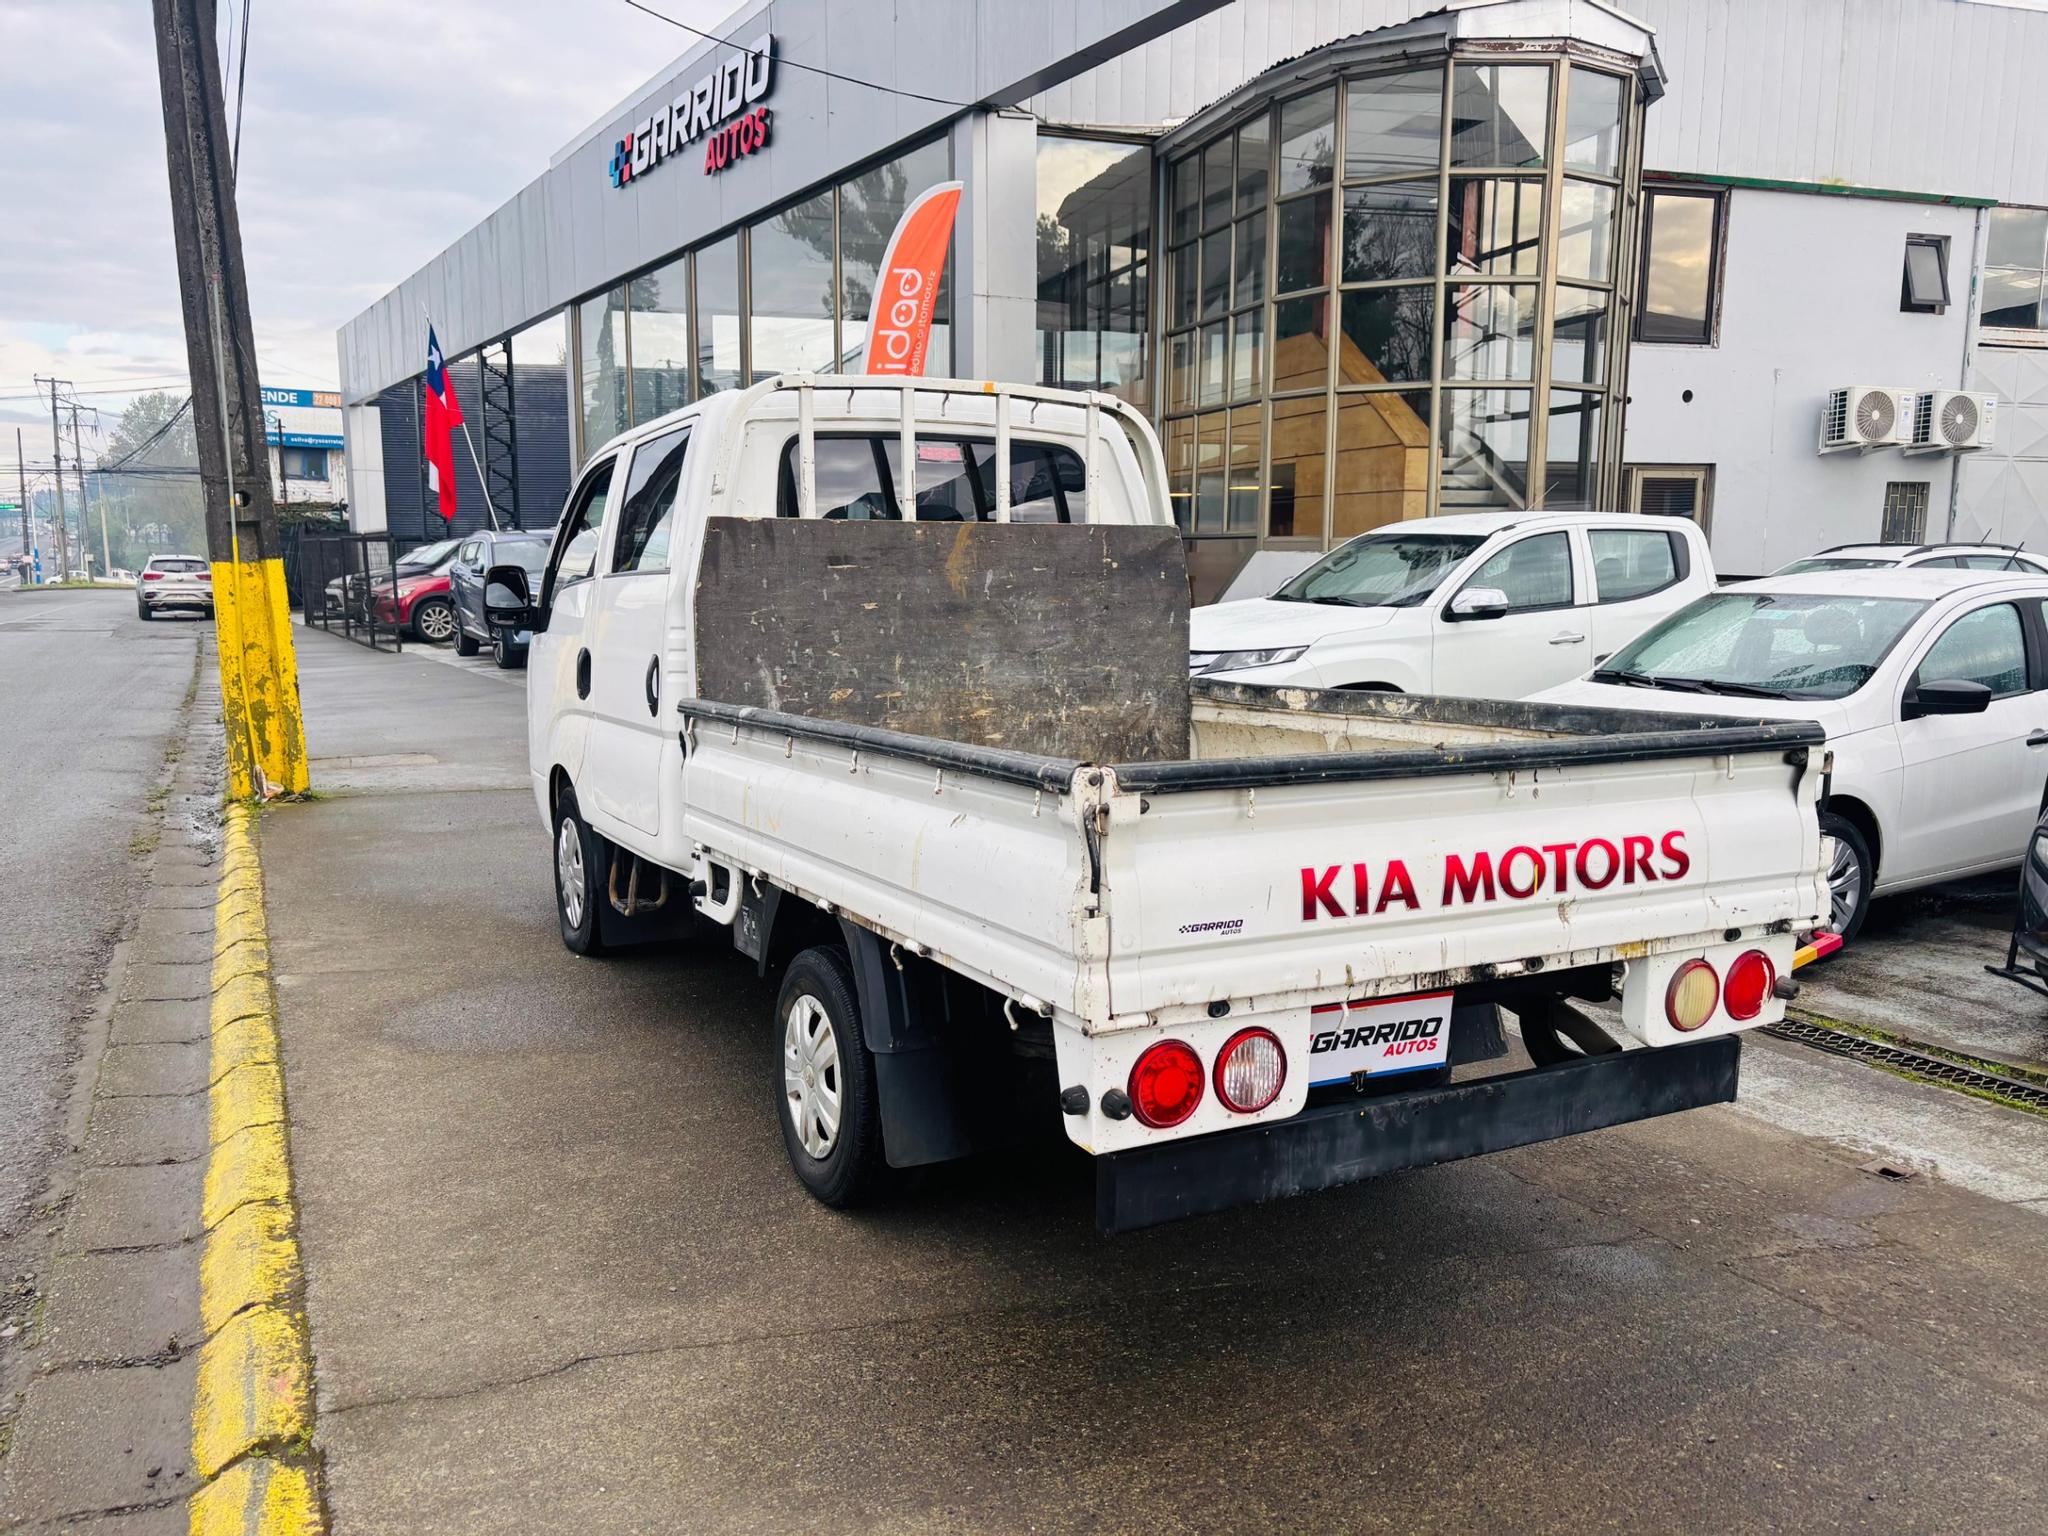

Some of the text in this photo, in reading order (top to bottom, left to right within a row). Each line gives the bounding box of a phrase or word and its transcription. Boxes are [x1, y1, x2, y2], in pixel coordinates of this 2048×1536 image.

[631, 32, 773, 177] GARRIDO
[703, 106, 768, 176] AUTOS
[876, 267, 923, 369] idad
[916, 269, 937, 338] automotriz
[1300, 830, 1691, 922] KIA MOTORS
[1191, 919, 1244, 933] GARRIDO
[1220, 928, 1242, 936] AUTOS
[1310, 1016, 1444, 1055] GARRIDO
[1383, 1037, 1438, 1058] AUTOS
